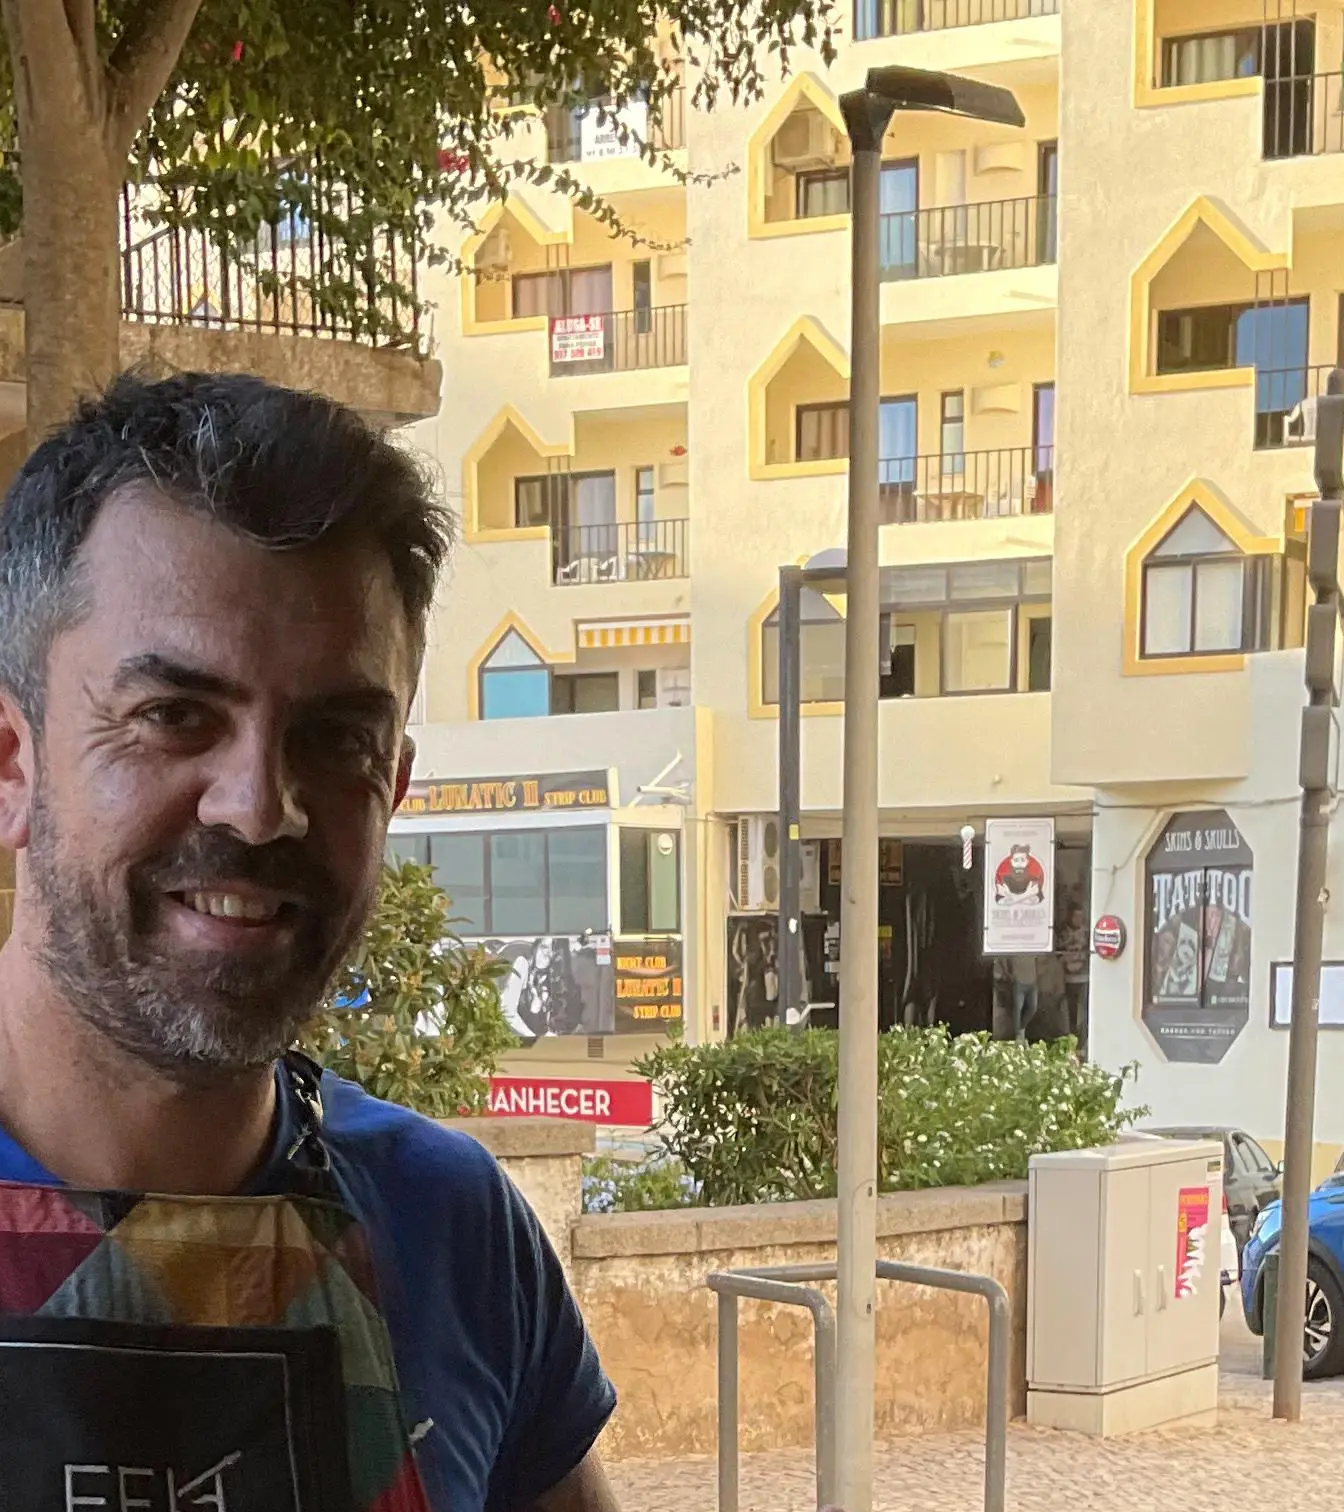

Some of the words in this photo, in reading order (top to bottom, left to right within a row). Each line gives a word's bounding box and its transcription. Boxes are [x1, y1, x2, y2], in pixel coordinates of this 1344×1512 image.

[429, 781, 516, 811] LUNATIC
[544, 791, 576, 806] STRIP
[579, 789, 607, 805] CLUB
[1165, 831, 1192, 852] SKINS
[1204, 828, 1240, 850] SKULLS
[616, 979, 670, 998] LUNATIC
